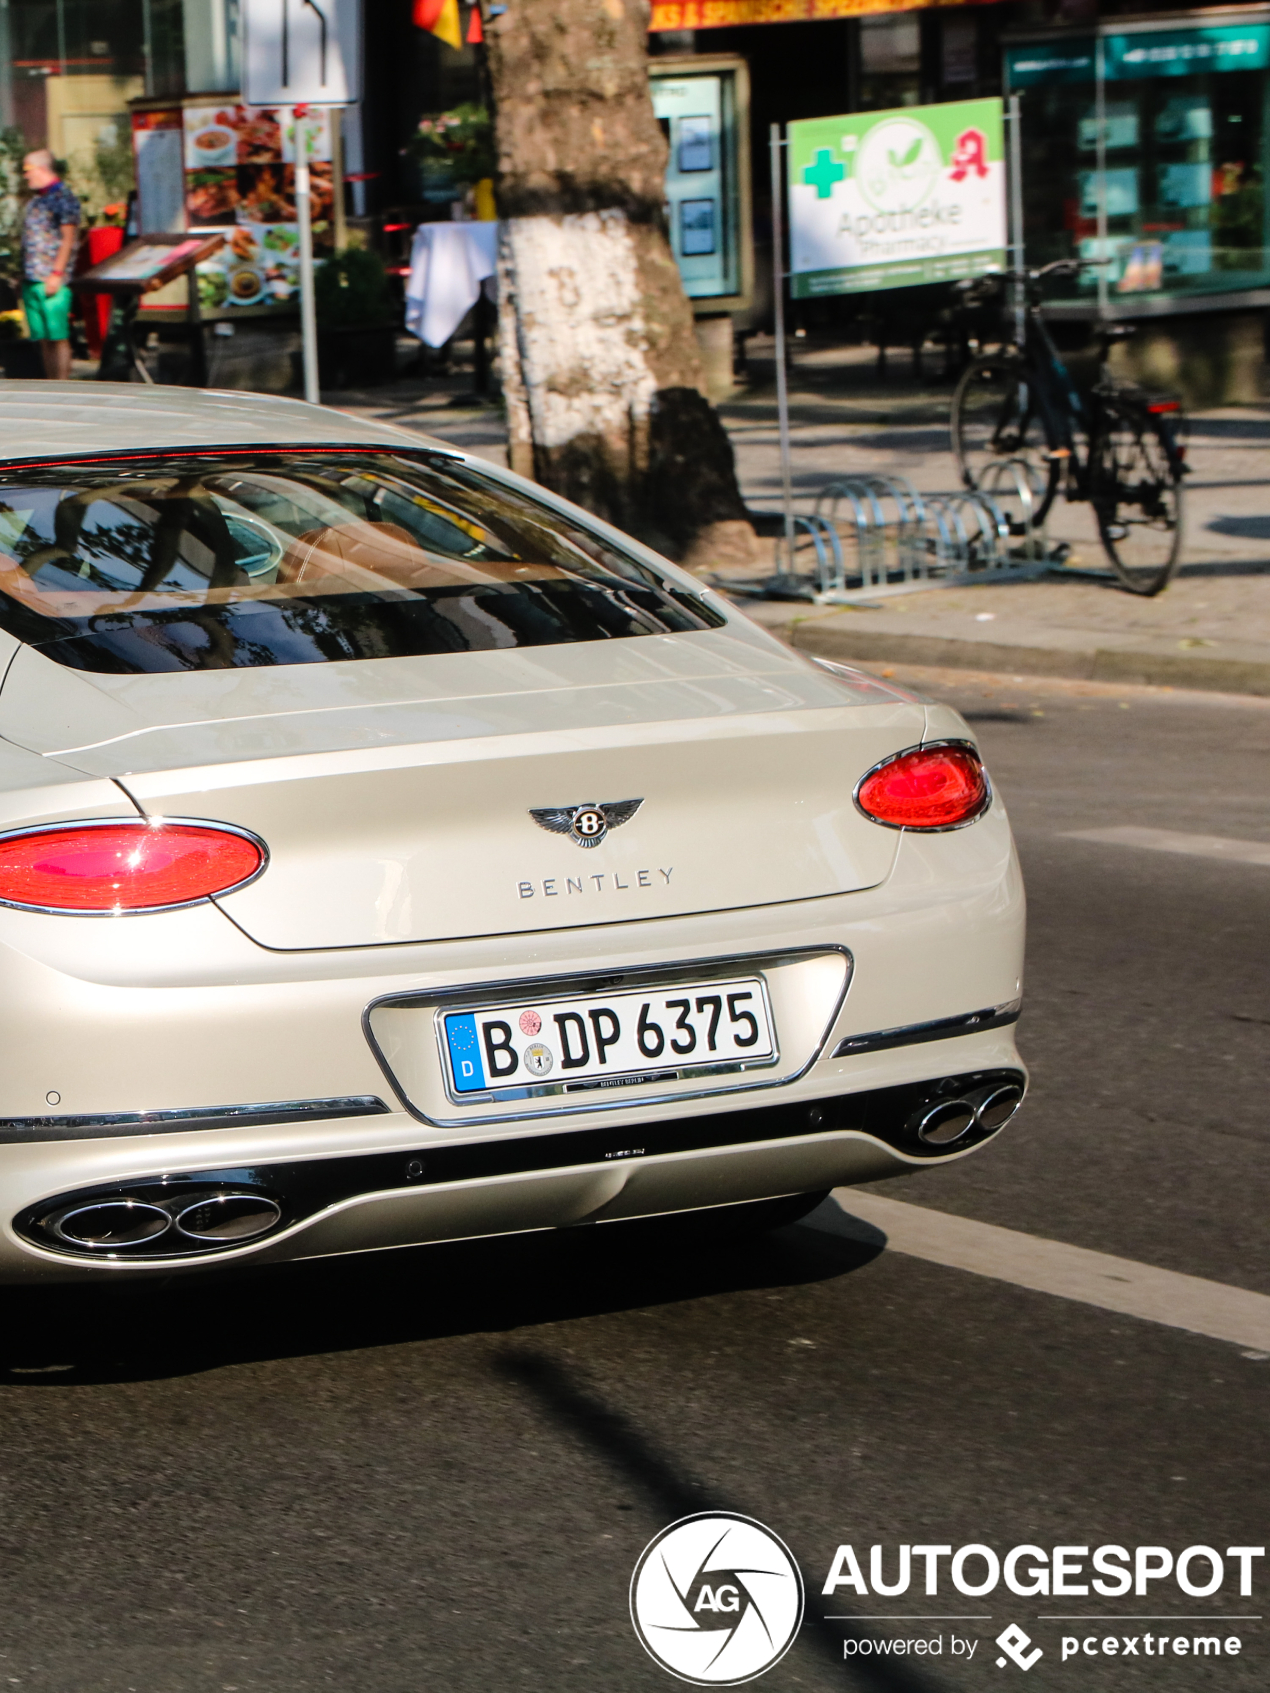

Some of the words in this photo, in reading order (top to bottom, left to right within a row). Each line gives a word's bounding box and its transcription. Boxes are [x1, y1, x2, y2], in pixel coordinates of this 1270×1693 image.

[836, 199, 963, 238] Apotheke
[860, 235, 947, 258] Pharmacy
[580, 812, 600, 835] B
[516, 867, 673, 899] BENTLEY
[482, 1020, 519, 1078] B
[553, 1007, 620, 1069] DP
[637, 991, 759, 1059] 6375
[461, 1060, 474, 1077] D
